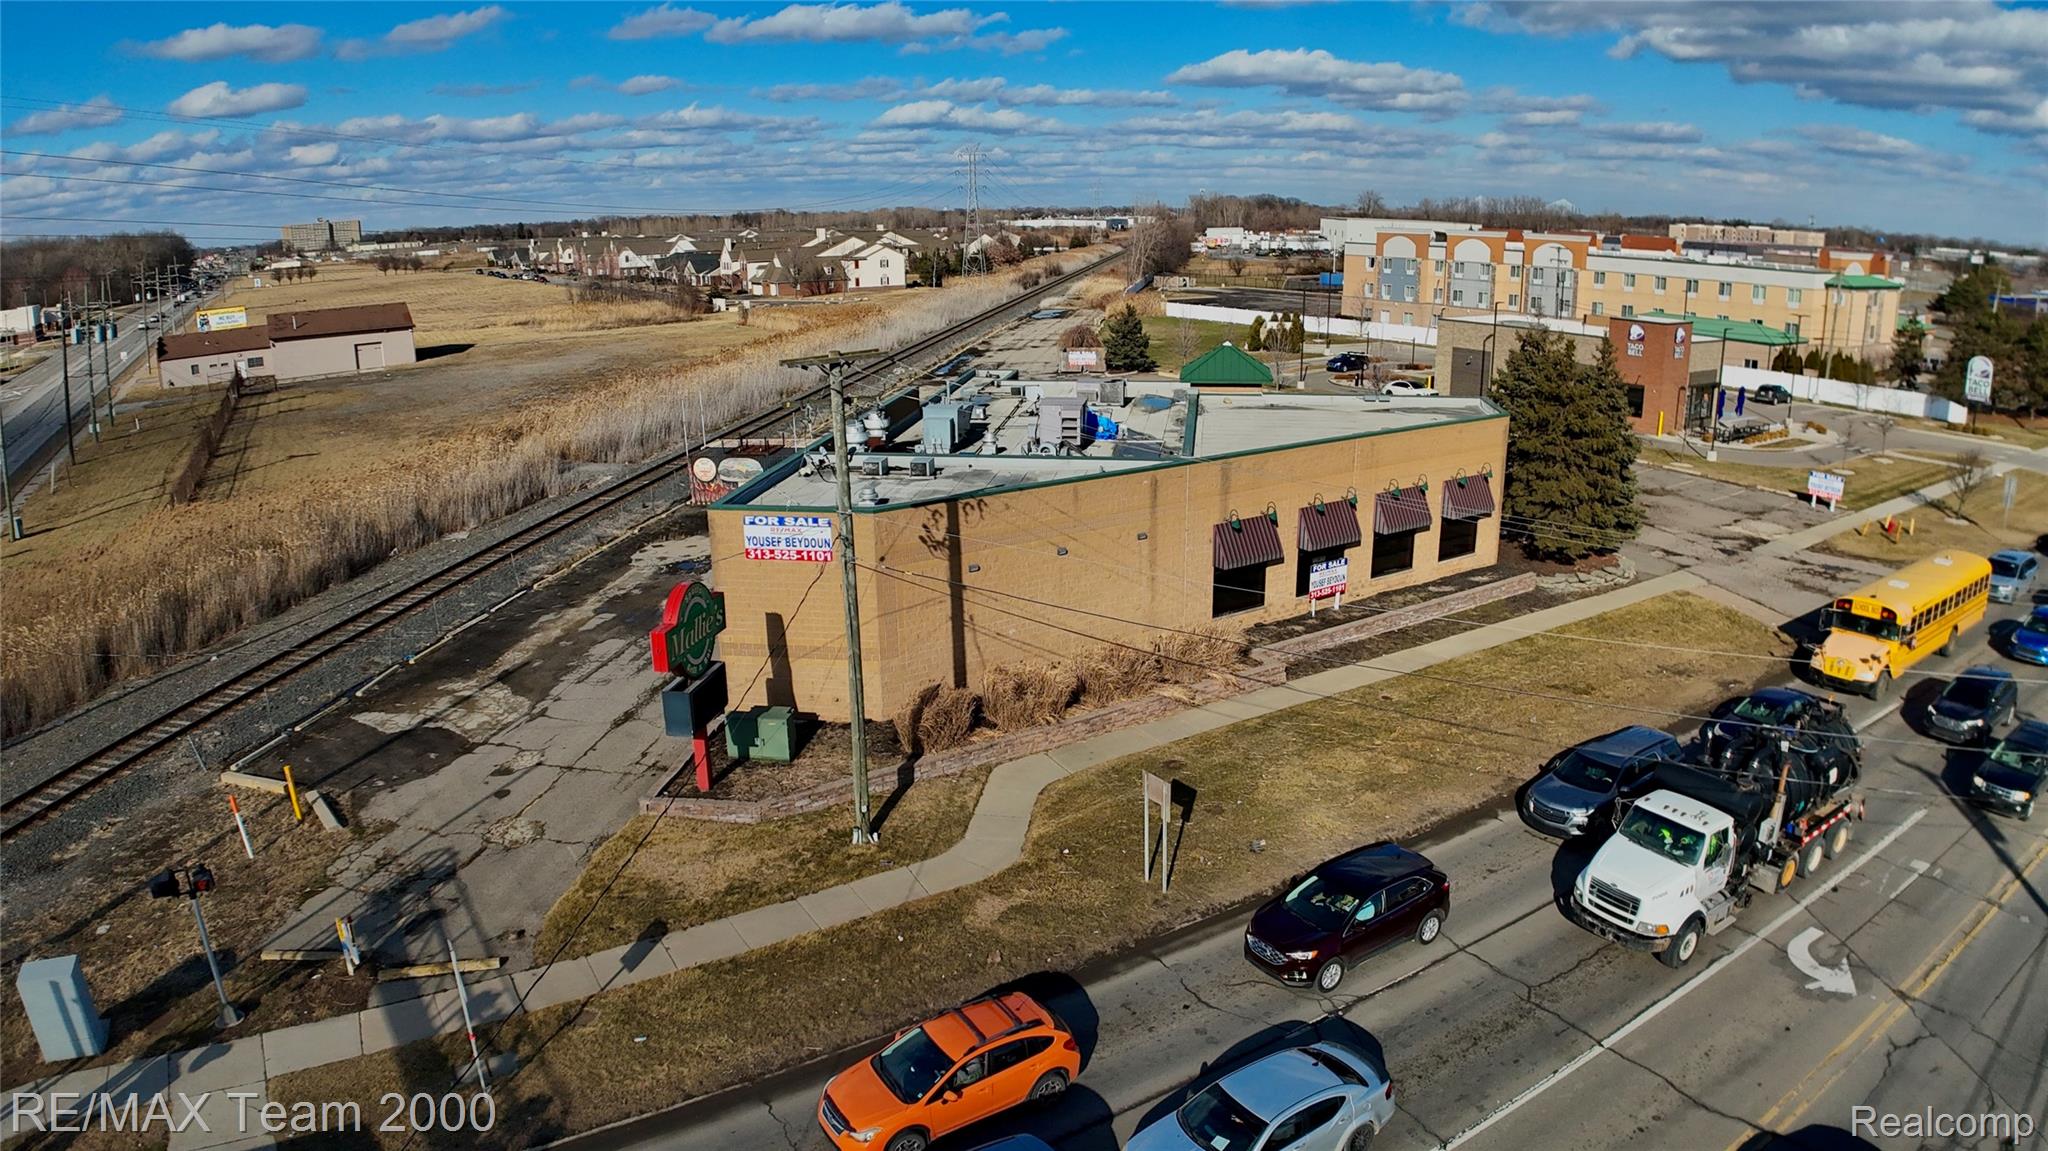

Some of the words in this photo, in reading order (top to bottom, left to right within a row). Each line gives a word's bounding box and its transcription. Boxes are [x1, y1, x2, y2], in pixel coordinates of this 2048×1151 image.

[1627, 342, 1645, 351] TACO
[1627, 349, 1643, 357] BELL
[1968, 378, 1990, 388] TACO
[1968, 386, 1989, 395] BELL
[744, 515, 780, 526] FOR
[784, 516, 829, 527] SALE
[746, 535, 782, 547] YOUSEF
[785, 537, 831, 549] BEYDOUN
[747, 548, 832, 561] 313-525-1101
[1312, 562, 1327, 573] FOR
[1328, 557, 1346, 568] SALE
[671, 604, 724, 662] Mallie's
